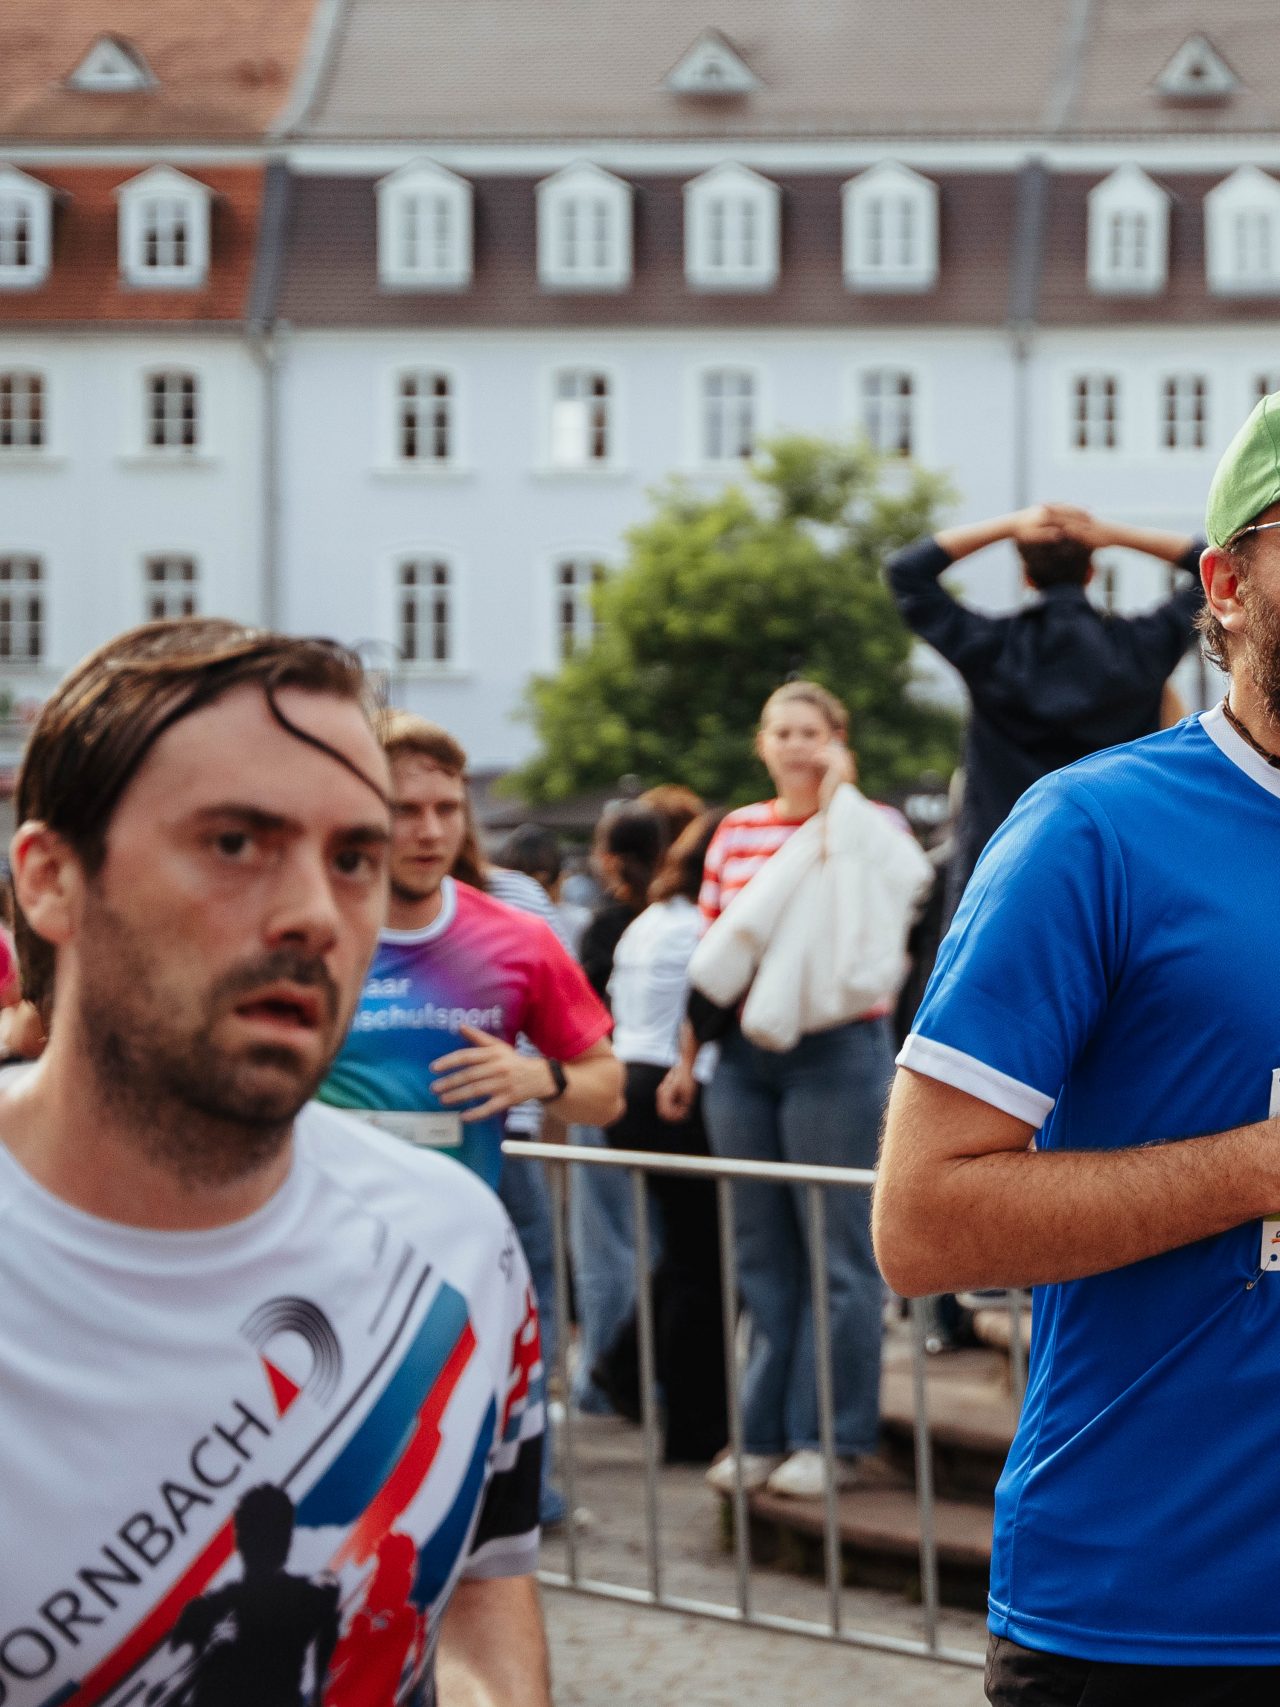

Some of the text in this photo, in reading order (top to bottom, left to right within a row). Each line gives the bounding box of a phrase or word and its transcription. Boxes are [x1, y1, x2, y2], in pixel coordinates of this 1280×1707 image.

[363, 977, 412, 995] aar
[353, 1003, 502, 1033] schulsport
[0, 1399, 272, 1707] ORNBACH
